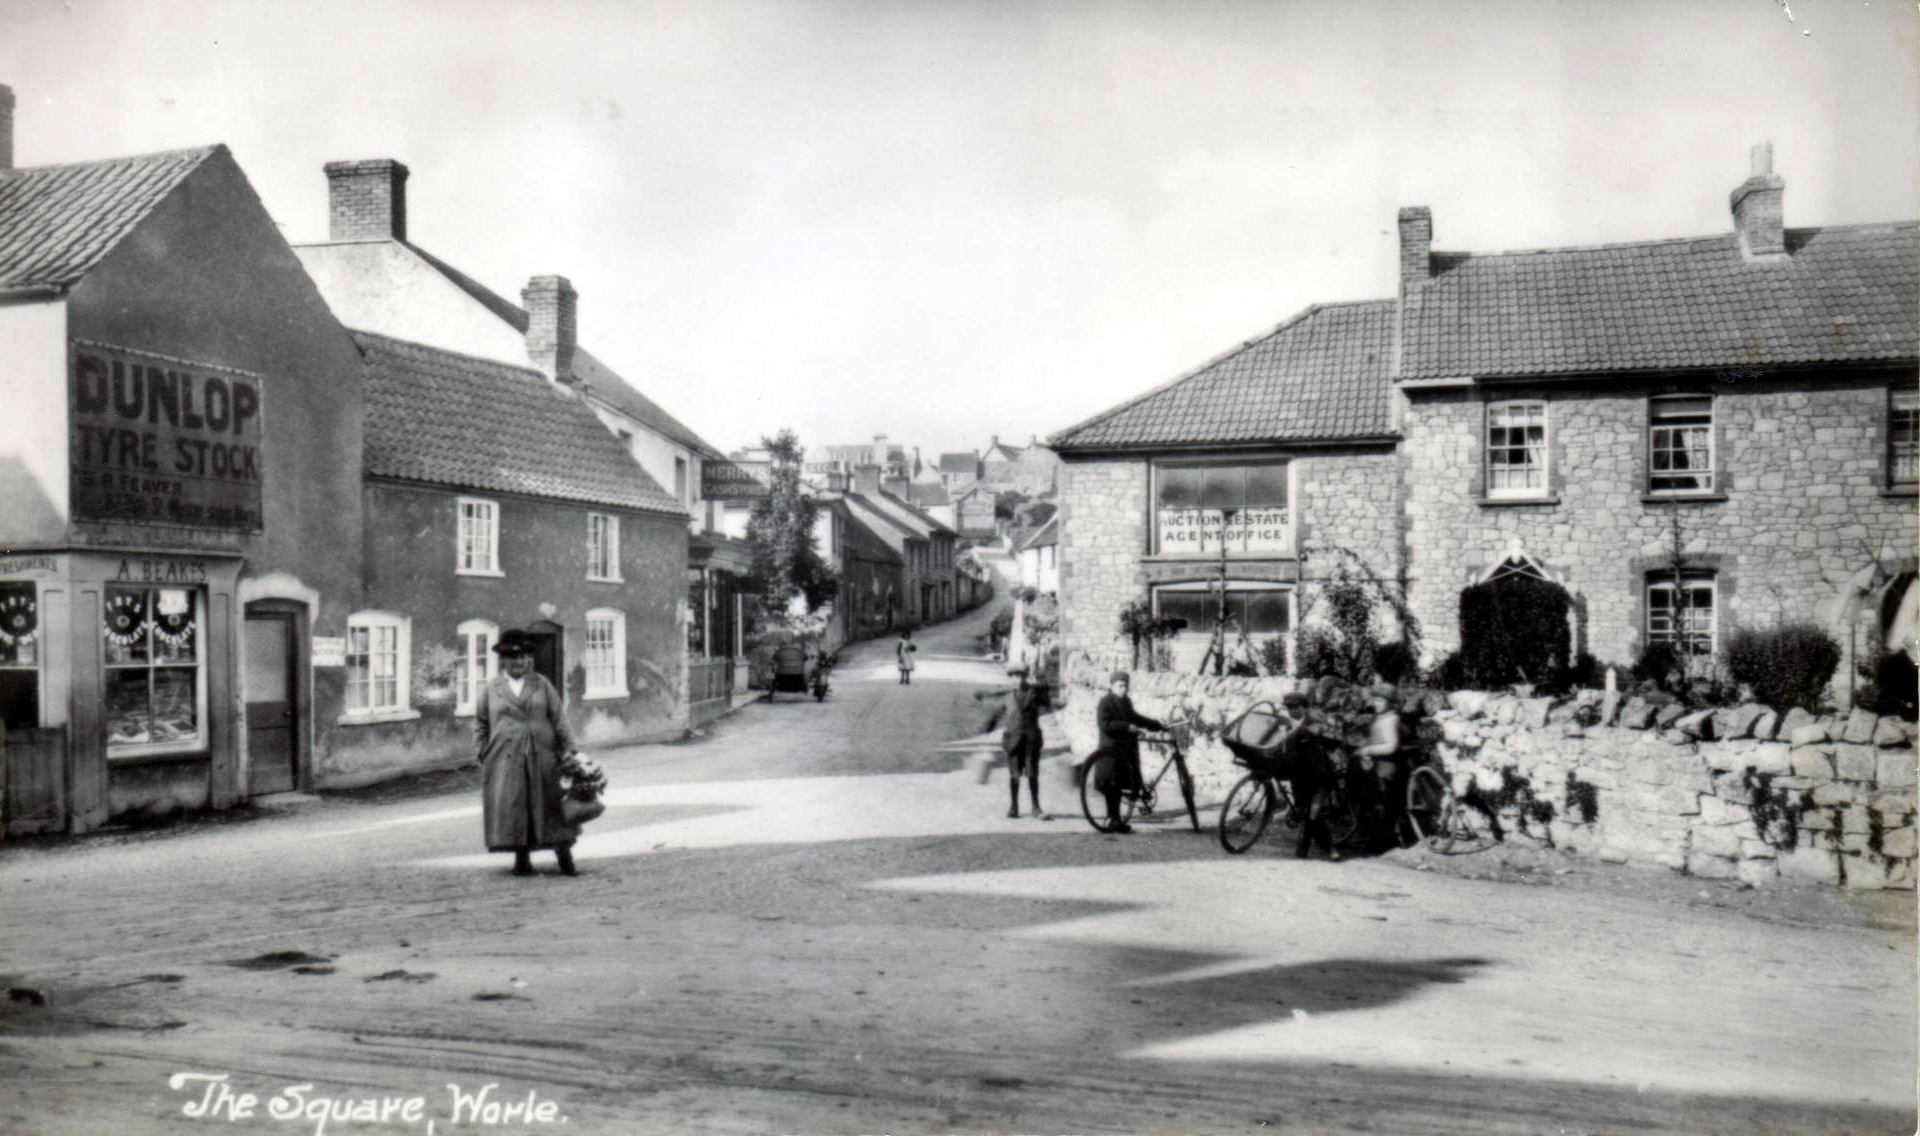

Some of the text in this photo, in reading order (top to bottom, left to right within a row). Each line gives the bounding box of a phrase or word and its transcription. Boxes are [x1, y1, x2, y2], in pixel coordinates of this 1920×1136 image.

[75, 353, 259, 435] DUNLOP
[76, 424, 258, 480] TYRE STOCK
[1158, 514, 1220, 527] AUCTION
[1235, 513, 1289, 526] ESTATE
[1165, 530, 1282, 541] AGENT OFFICE
[143, 559, 207, 582] BEAKES
